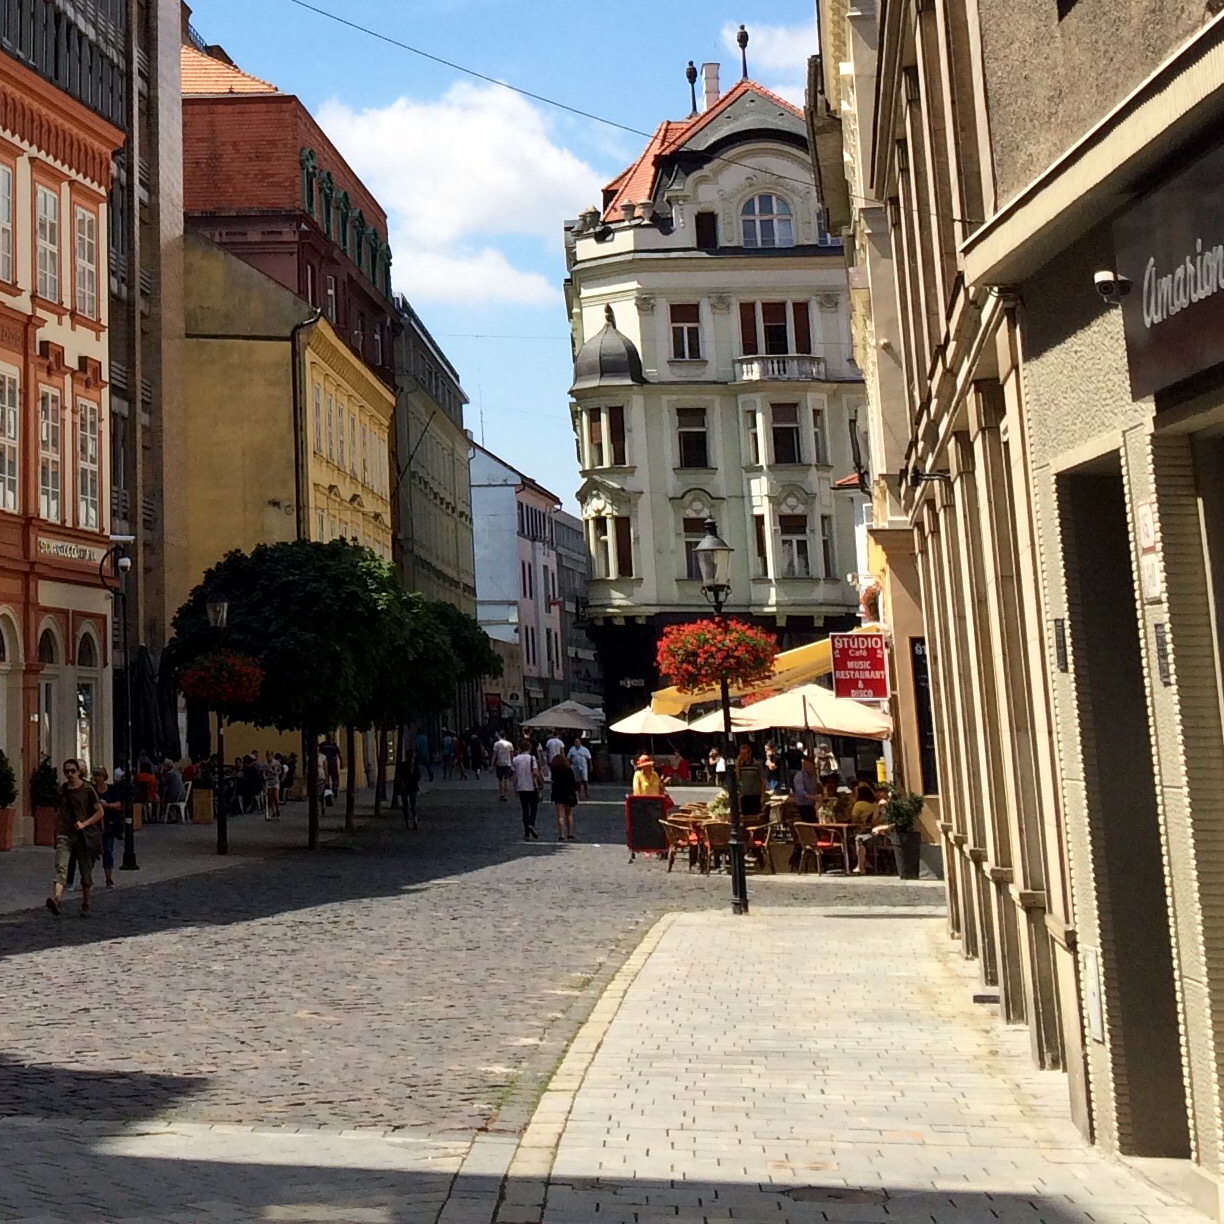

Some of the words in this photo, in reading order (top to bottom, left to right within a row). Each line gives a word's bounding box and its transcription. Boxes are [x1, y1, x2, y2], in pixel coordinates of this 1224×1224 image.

[847, 661, 871, 669] MUSIC
[835, 670, 885, 679] RESTAURANT
[858, 680, 864, 688] &
[851, 689, 873, 697] DISCO
